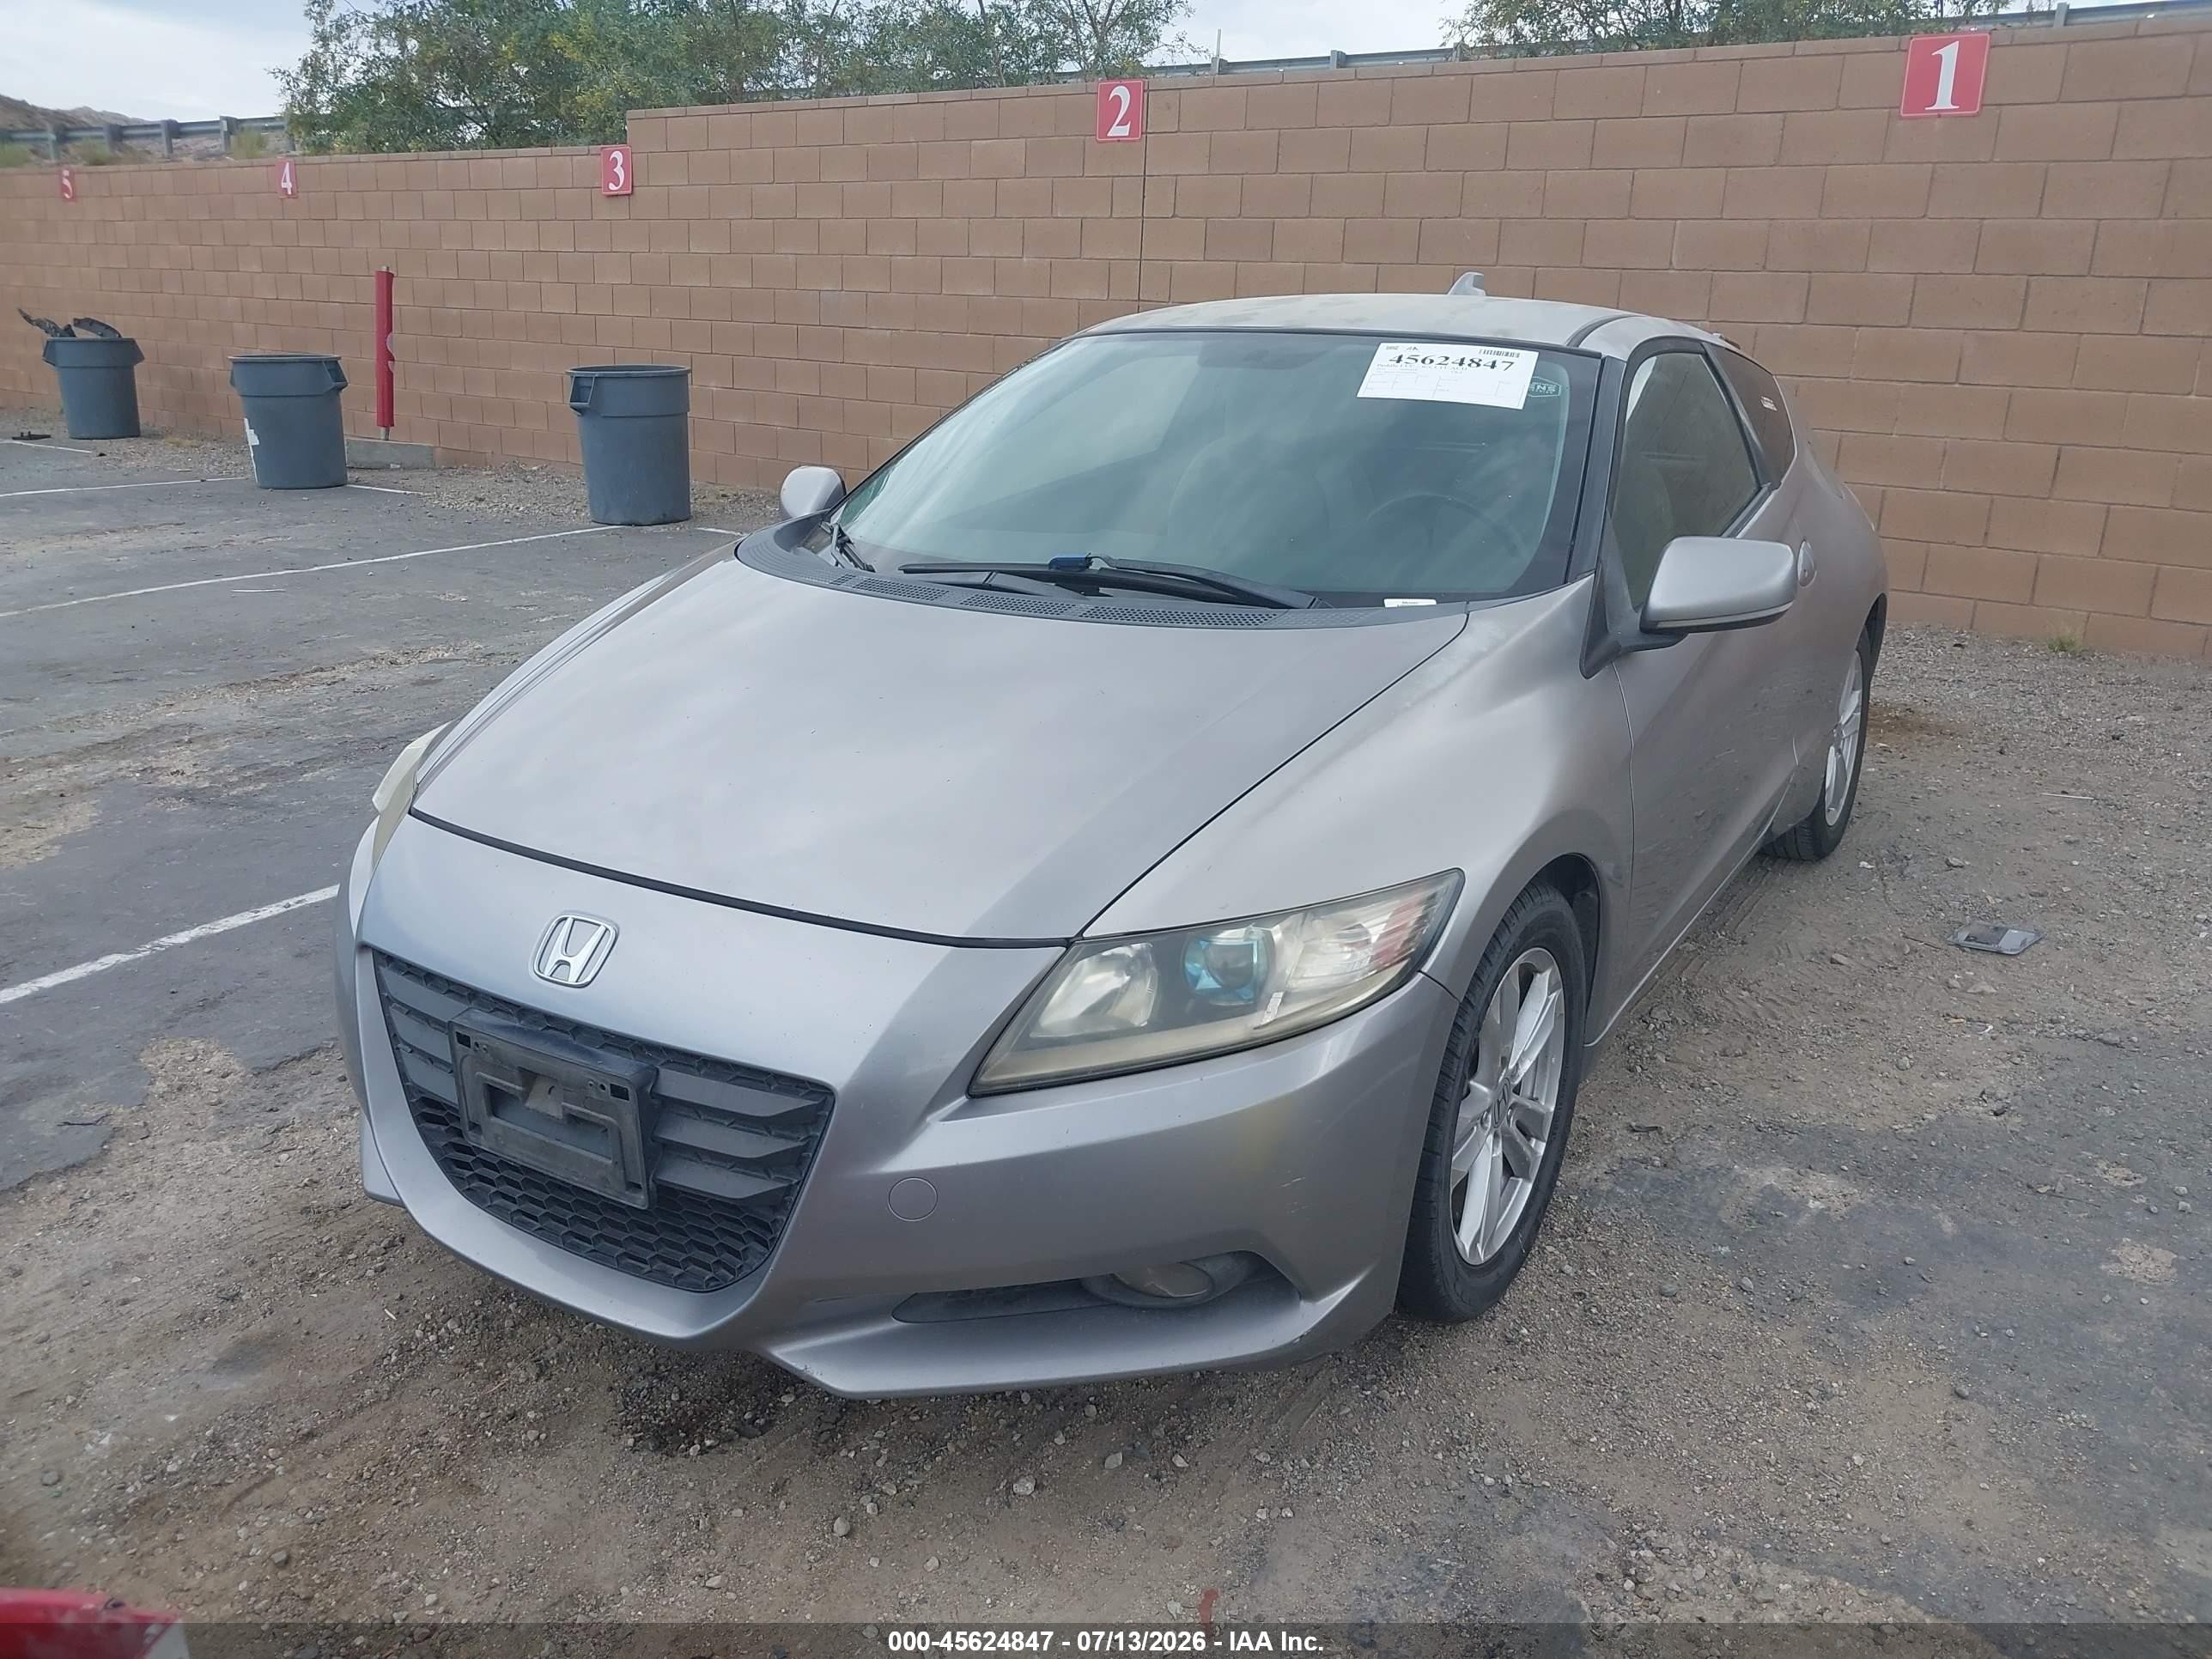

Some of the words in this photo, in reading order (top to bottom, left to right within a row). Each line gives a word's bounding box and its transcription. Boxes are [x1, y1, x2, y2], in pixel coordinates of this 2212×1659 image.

[1924, 40, 1960, 110] 1
[1107, 85, 1131, 137] 2
[62, 170, 73, 199] 5
[281, 161, 293, 195] 4
[608, 150, 625, 191] 3
[1388, 353, 1516, 372] 45624847
